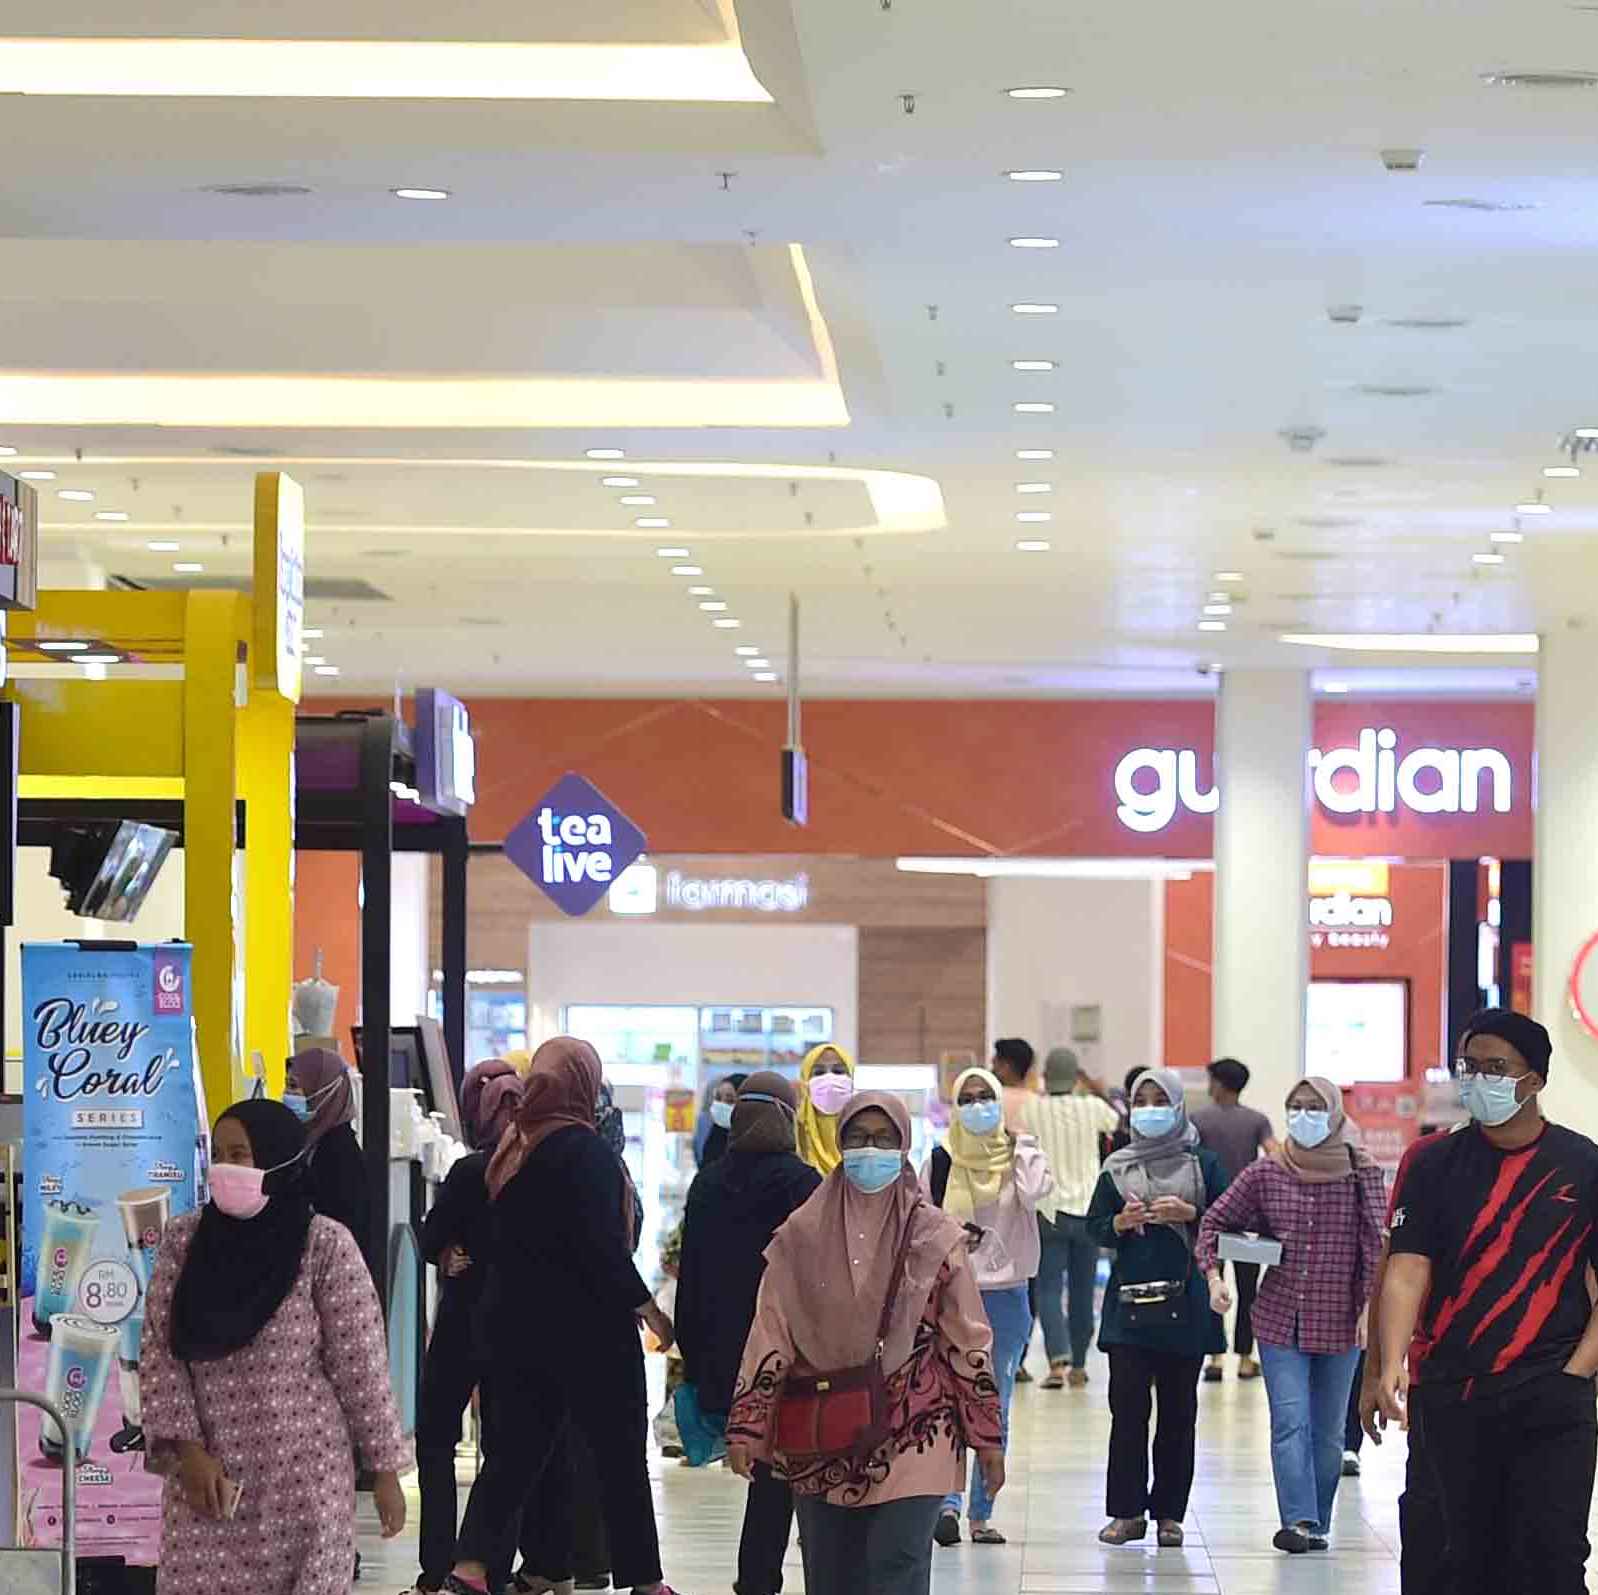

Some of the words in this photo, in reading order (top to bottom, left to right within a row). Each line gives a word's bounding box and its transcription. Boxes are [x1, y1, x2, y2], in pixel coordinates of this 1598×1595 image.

[1114, 727, 1512, 833] gudian
[537, 807, 612, 846] tea
[541, 845, 612, 883] live
[33, 997, 150, 1060] Bluey
[47, 1047, 164, 1100] Coral
[76, 1110, 139, 1124] SERIES
[98, 1269, 115, 1281] RM
[86, 1282, 128, 1308] 8.80
